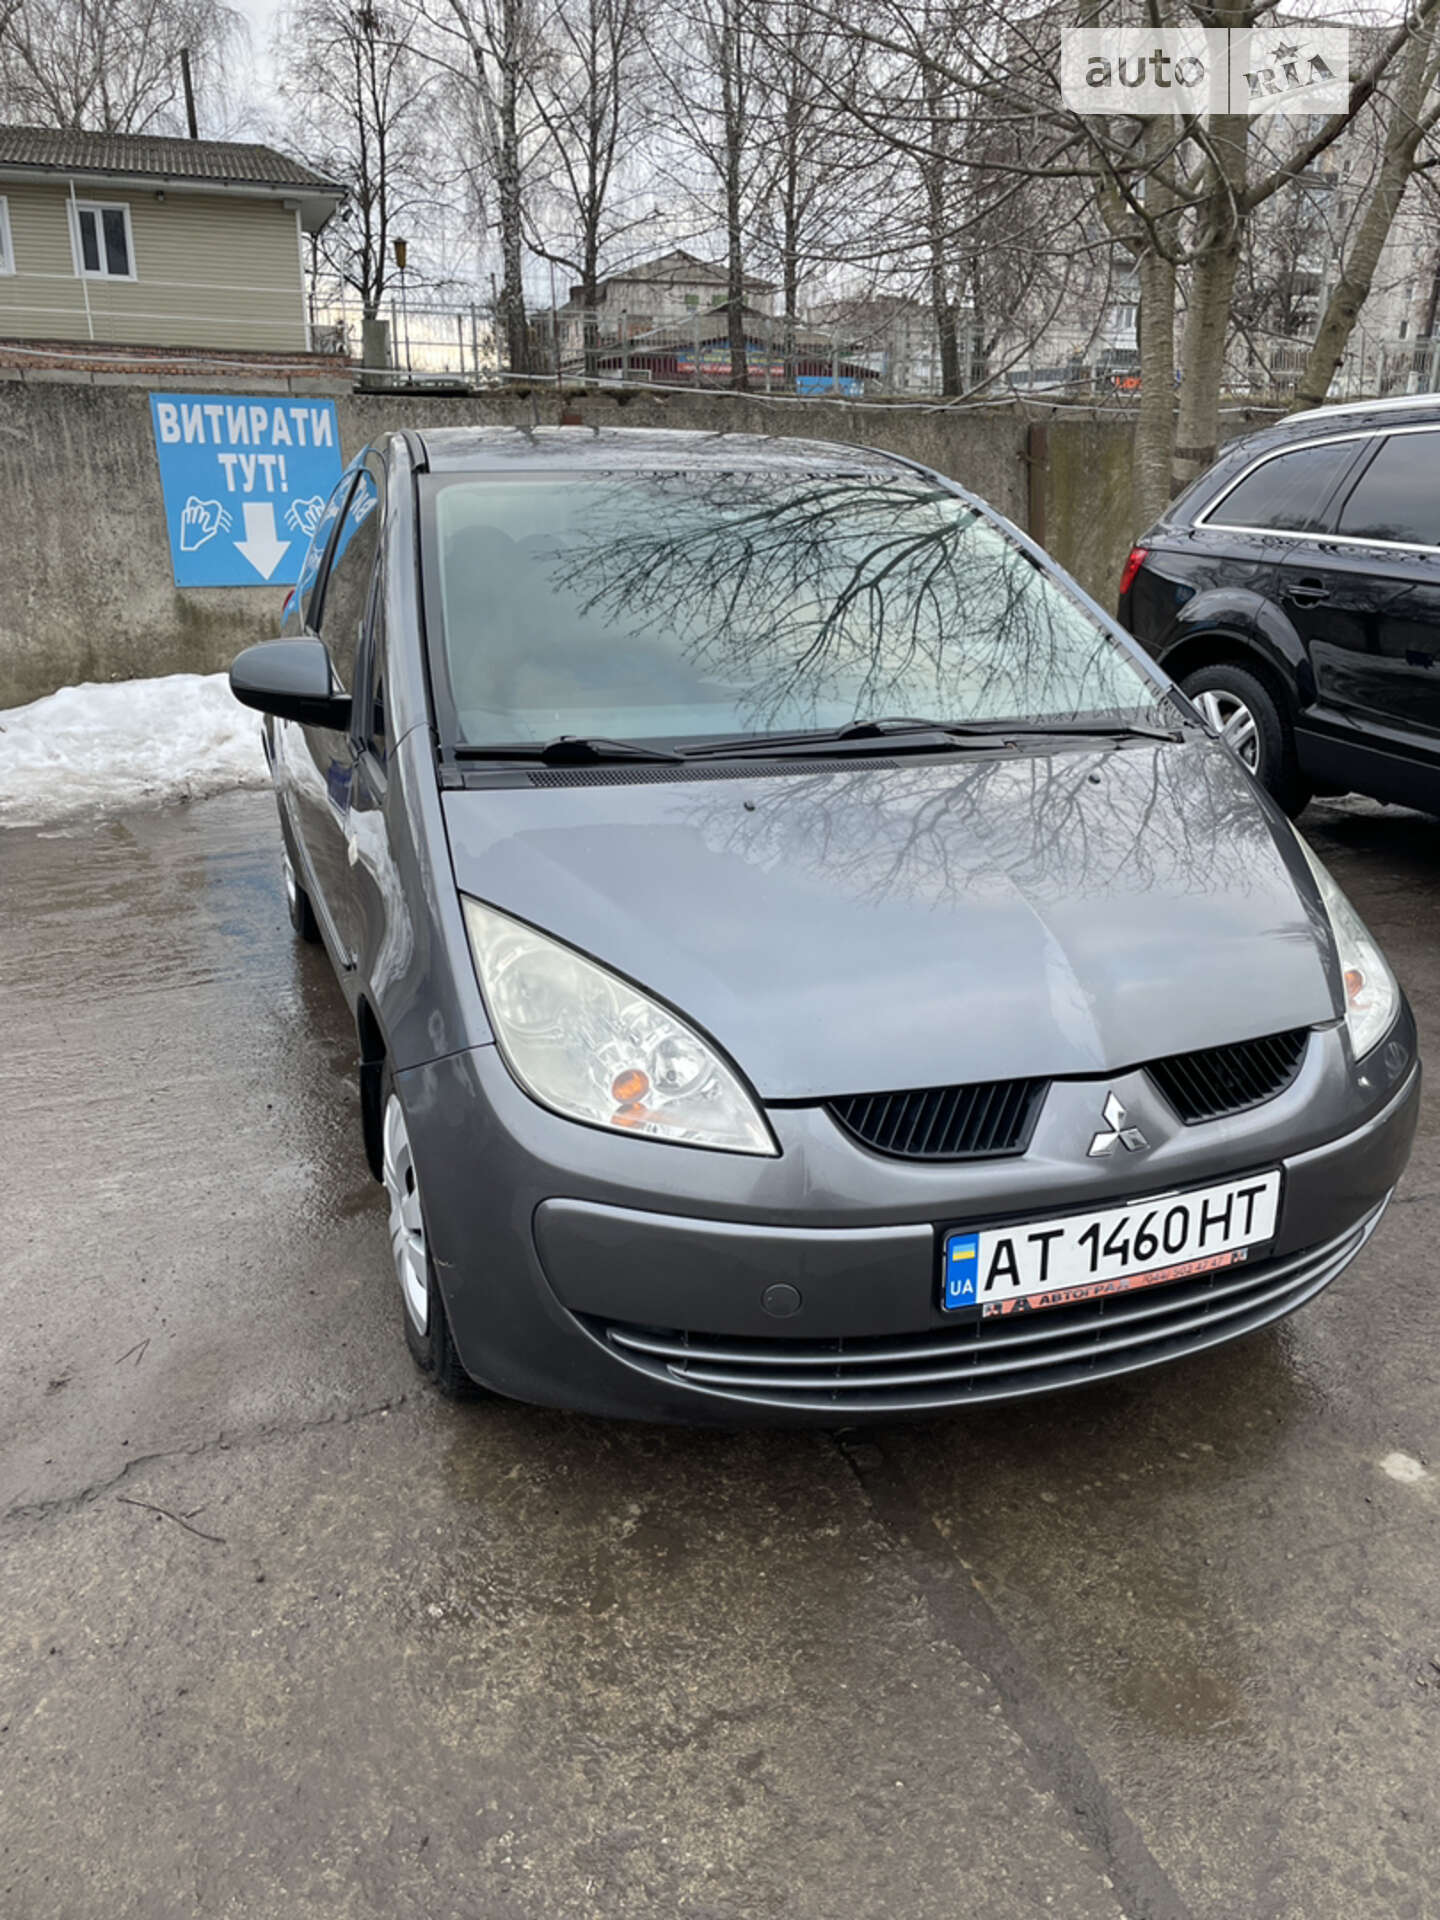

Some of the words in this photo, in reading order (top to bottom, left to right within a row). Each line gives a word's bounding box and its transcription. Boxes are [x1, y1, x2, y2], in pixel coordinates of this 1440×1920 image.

[157, 403, 334, 447] ВИТИРАТИ
[217, 453, 289, 493] ТУТ!
[984, 1228, 1065, 1291] AT
[1078, 1205, 1190, 1272] 1460
[1198, 1184, 1267, 1248] HT
[950, 1278, 974, 1296] UA
